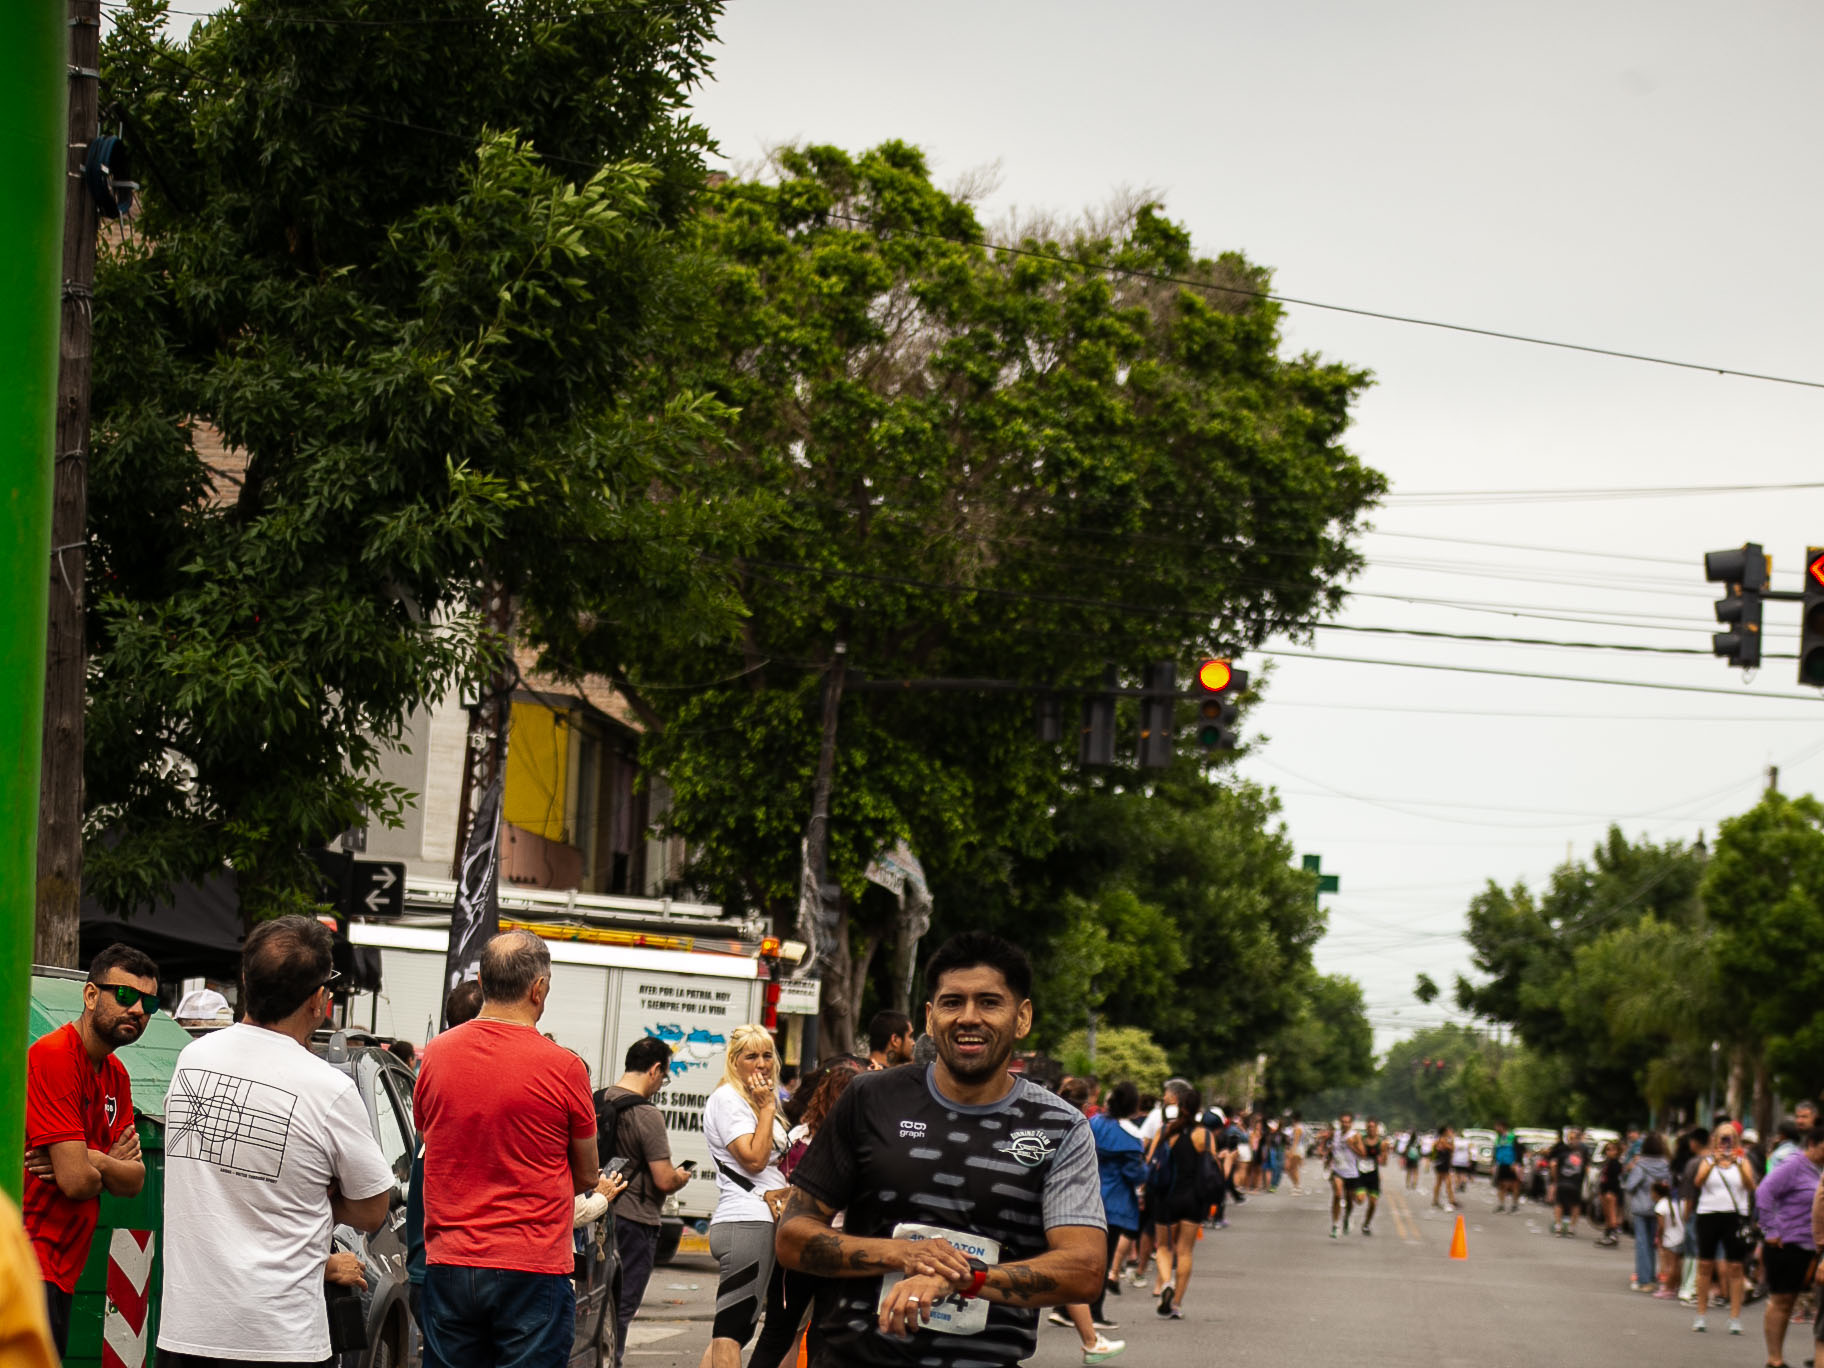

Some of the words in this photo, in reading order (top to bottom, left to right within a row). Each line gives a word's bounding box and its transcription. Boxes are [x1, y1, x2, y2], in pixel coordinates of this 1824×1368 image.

[639, 985, 657, 995] AYER
[659, 987, 674, 997] POR
[676, 988, 684, 998] LA
[715, 992, 731, 1001] HOY
[641, 1000, 646, 1008] Y
[647, 1000, 680, 1011] SIEMPRE
[681, 1003, 696, 1013] POR
[698, 1004, 706, 1014] LA
[709, 1005, 726, 1016] VIDA
[651, 1091, 668, 1106] OS
[900, 1130, 925, 1139] graph
[1036, 1130, 1051, 1146] TEAM
